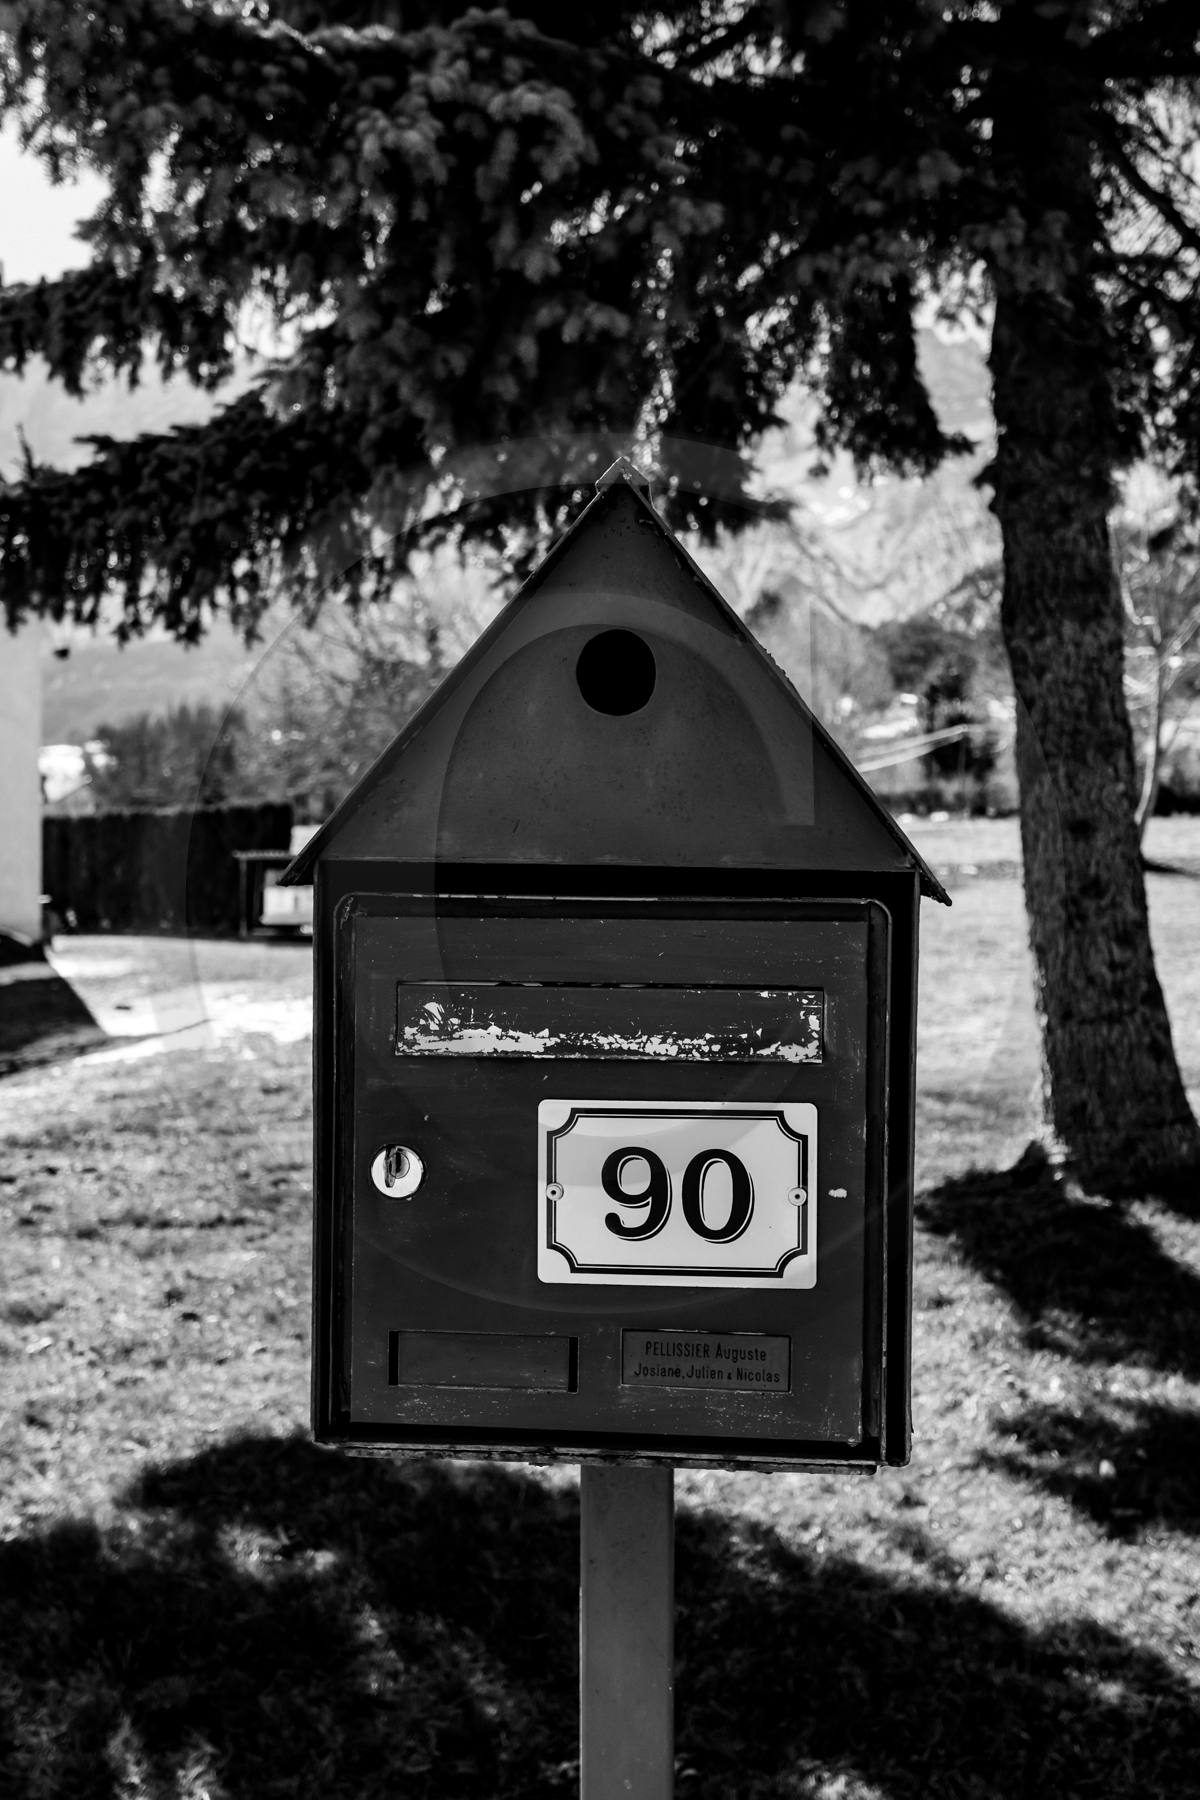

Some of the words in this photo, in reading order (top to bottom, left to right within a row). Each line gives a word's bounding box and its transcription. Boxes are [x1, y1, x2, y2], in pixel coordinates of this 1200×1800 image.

[602, 1146, 755, 1244] 90
[645, 1341, 710, 1358] PELLISSIER
[715, 1343, 767, 1363] Auguste
[727, 1372, 733, 1381] &
[736, 1367, 780, 1383] Nicolas
